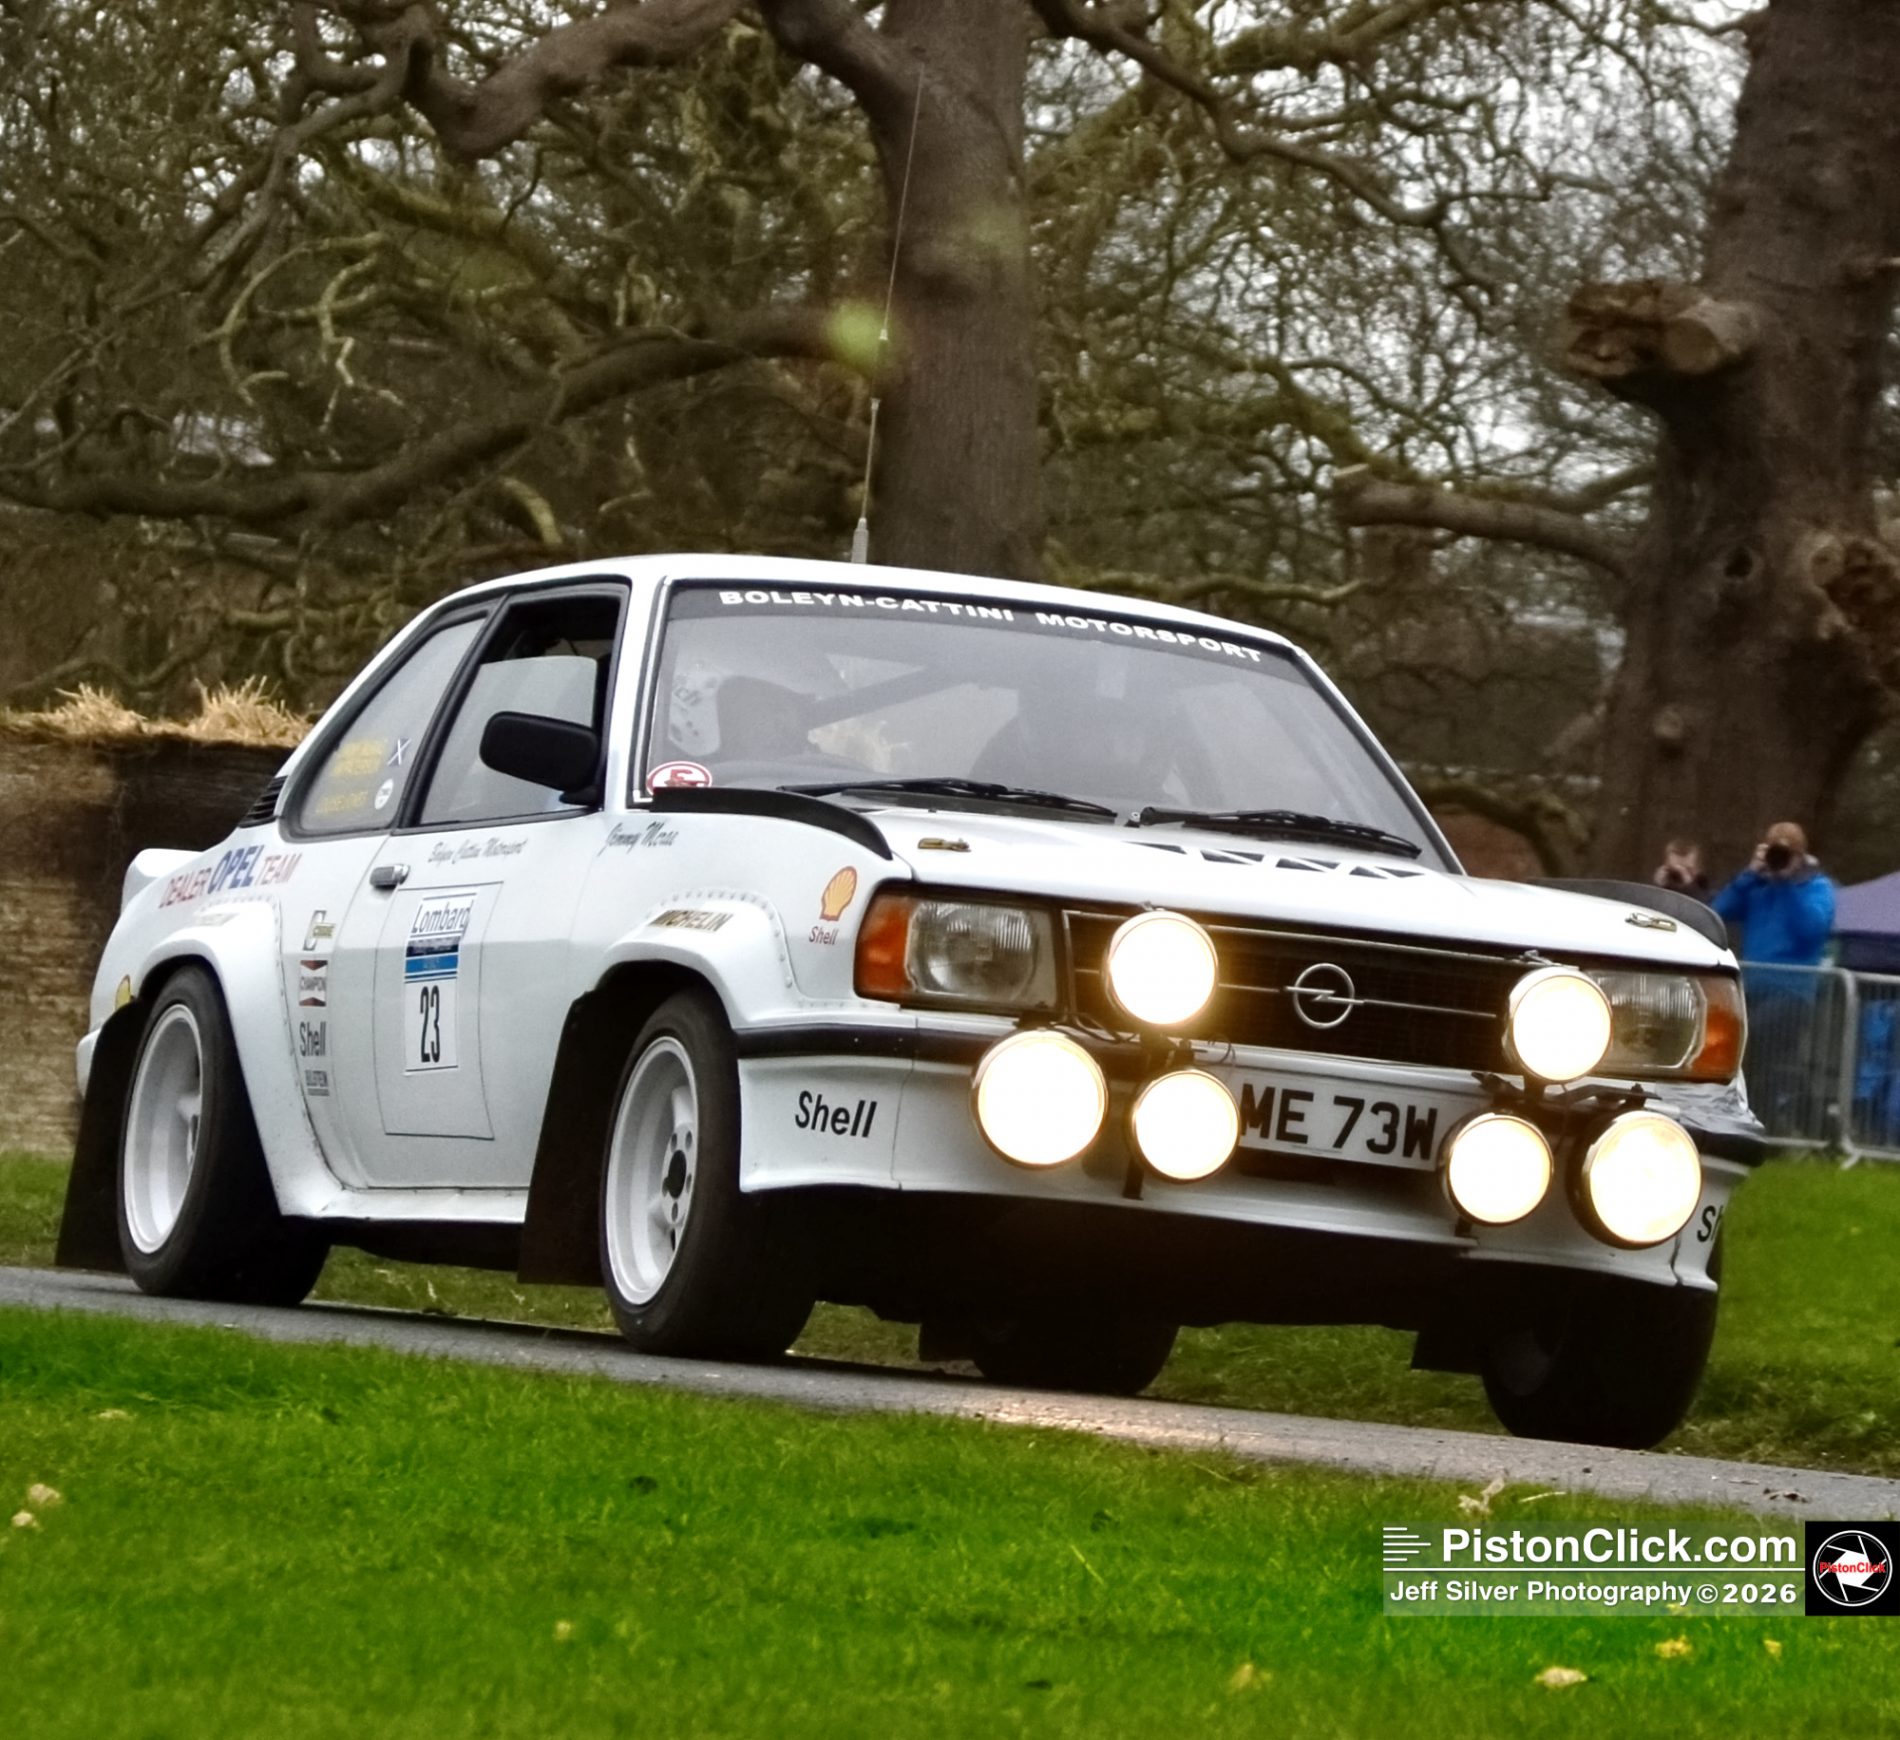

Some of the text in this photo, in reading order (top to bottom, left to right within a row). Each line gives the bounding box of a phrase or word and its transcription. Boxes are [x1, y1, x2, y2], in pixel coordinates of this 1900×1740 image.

[719, 591, 1262, 662] BOLEYN-CATTINI MOTORSPORT
[158, 844, 302, 909] DEALER OPEL TEAM
[411, 899, 475, 934] Lombard
[808, 926, 839, 946] Shell
[299, 1020, 327, 1057] Shell
[420, 985, 440, 1063] 23
[795, 1090, 877, 1138] Shell
[1333, 1095, 1438, 1161] 73W
